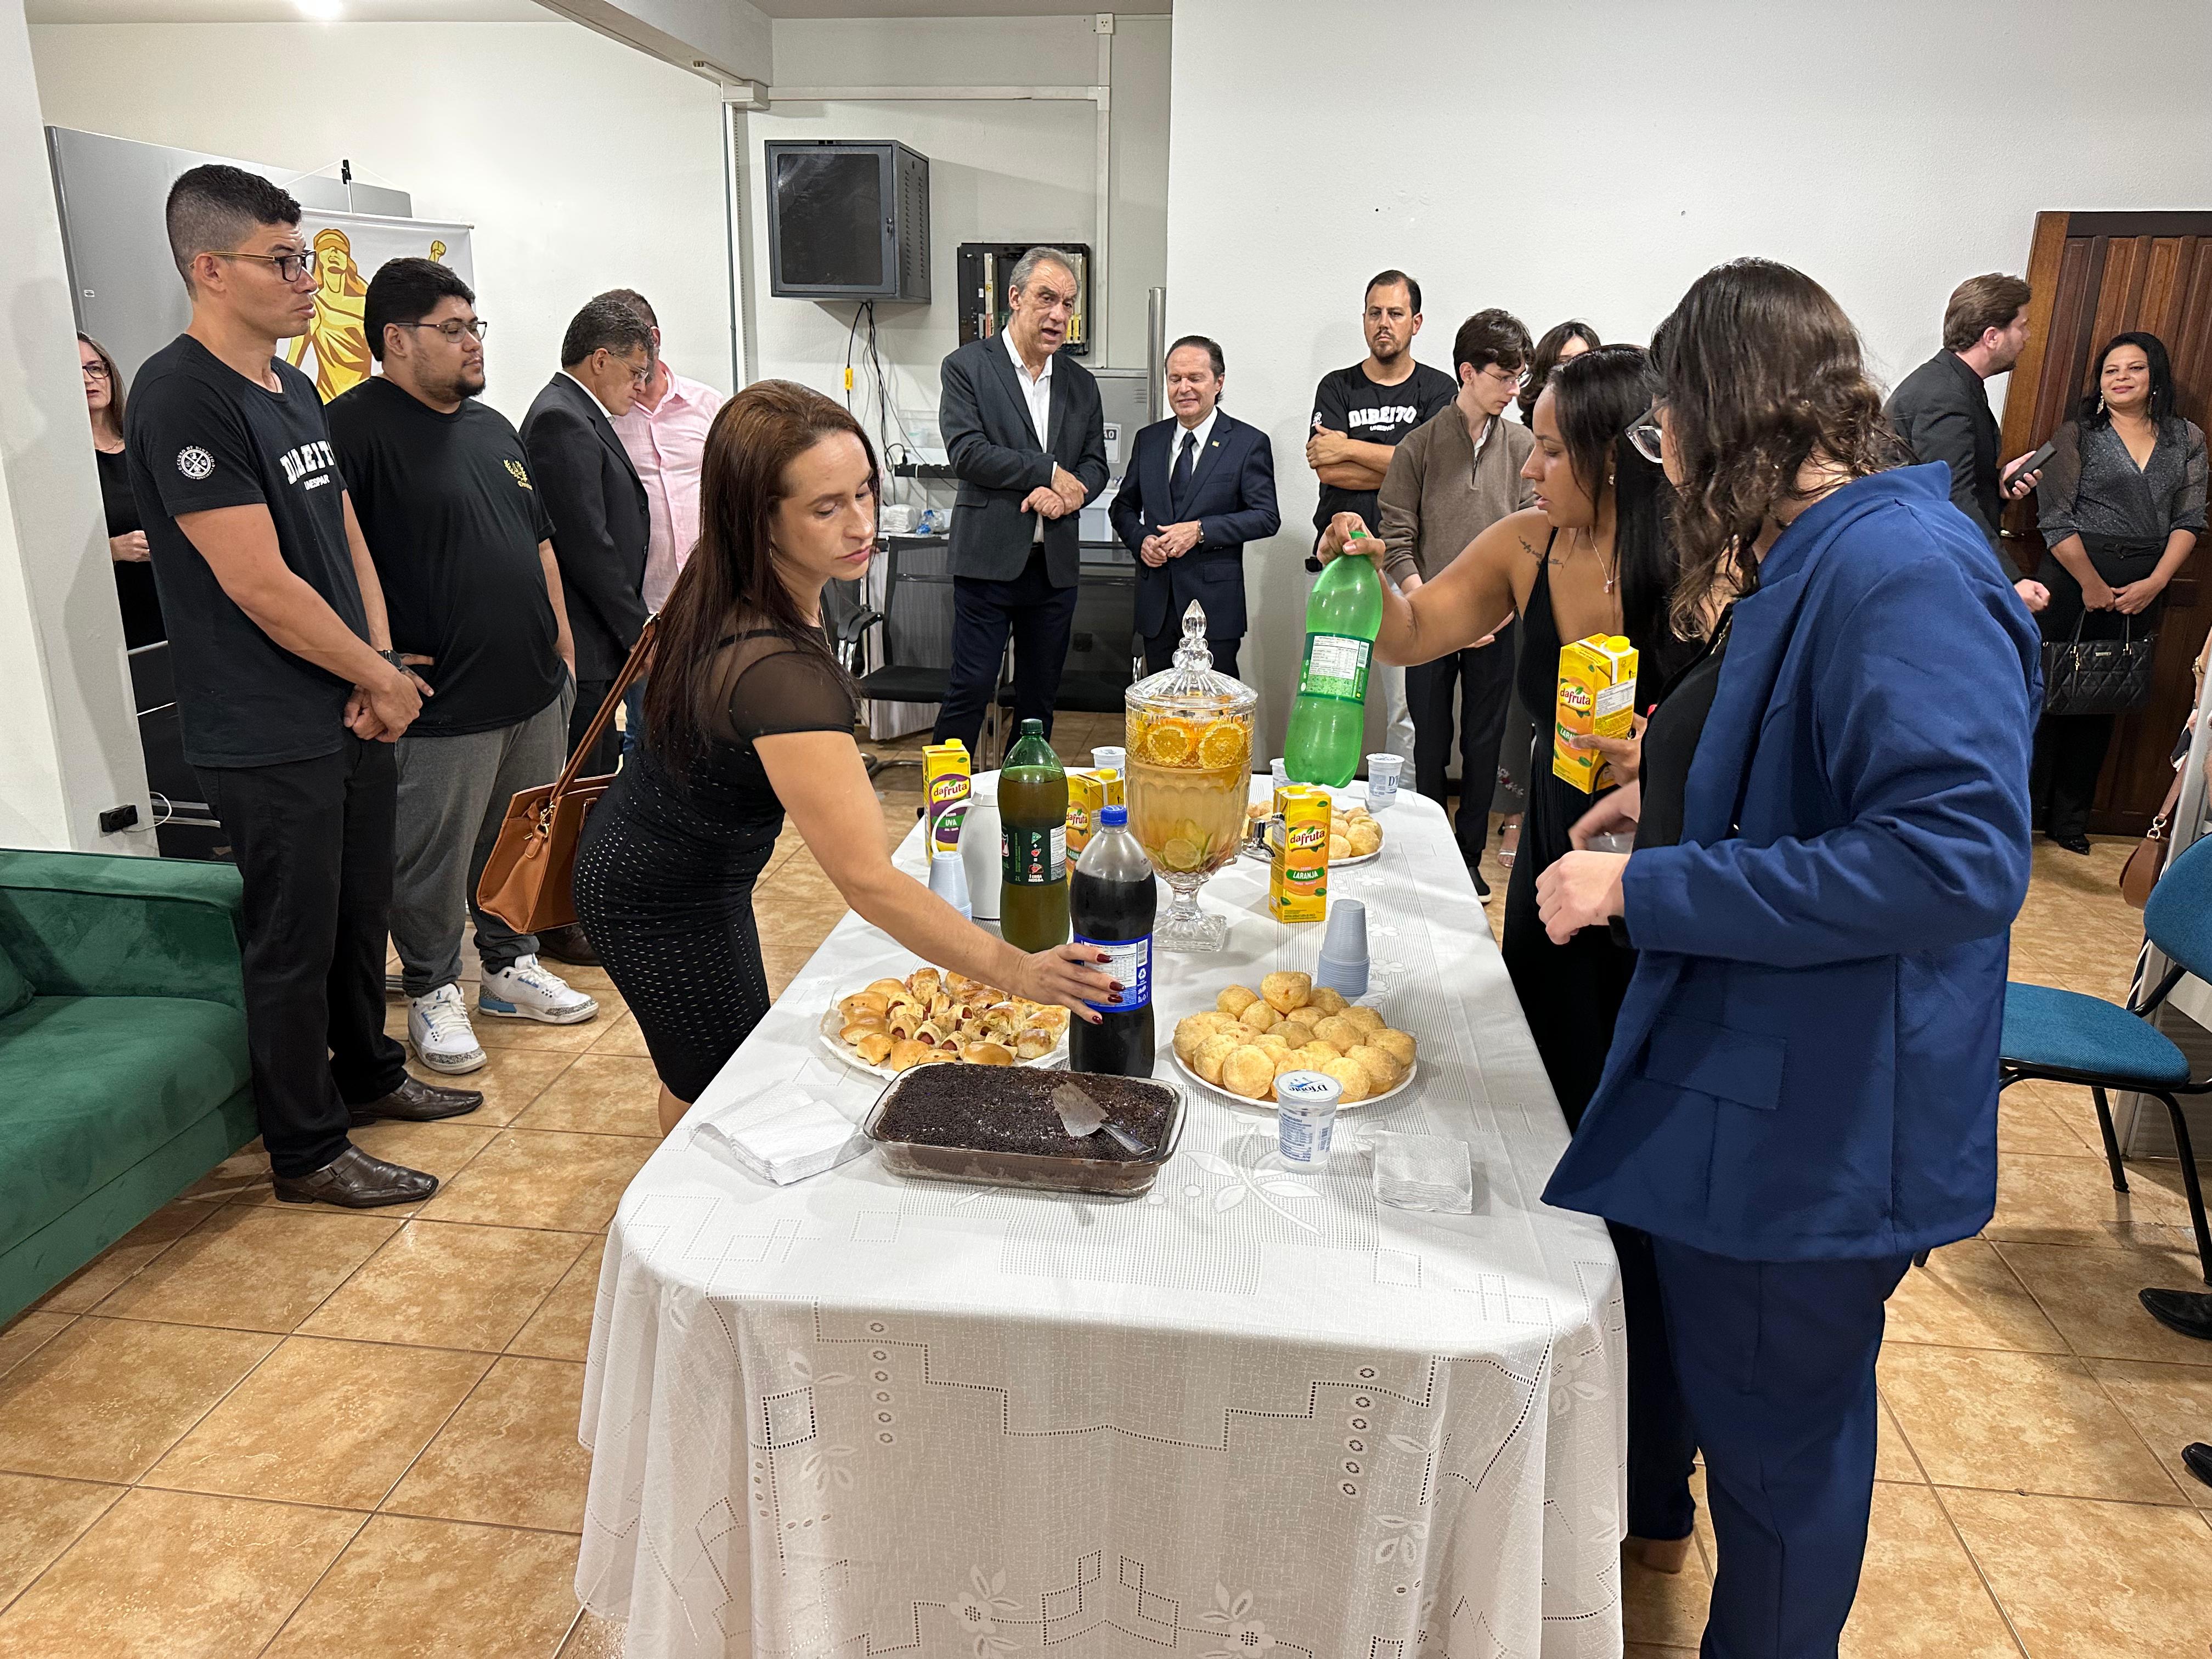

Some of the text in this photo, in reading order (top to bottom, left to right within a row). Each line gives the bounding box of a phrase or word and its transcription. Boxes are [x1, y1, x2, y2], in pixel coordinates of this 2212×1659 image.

[1348, 406, 1417, 428] DIREITO
[280, 441, 335, 484] DIREIT
[1560, 688, 1590, 705] dafruta
[934, 783, 967, 798] dafruta
[1066, 812, 1087, 825] dafruta
[1290, 830, 1325, 845] dafruta
[1293, 870, 1318, 879] LARANJA
